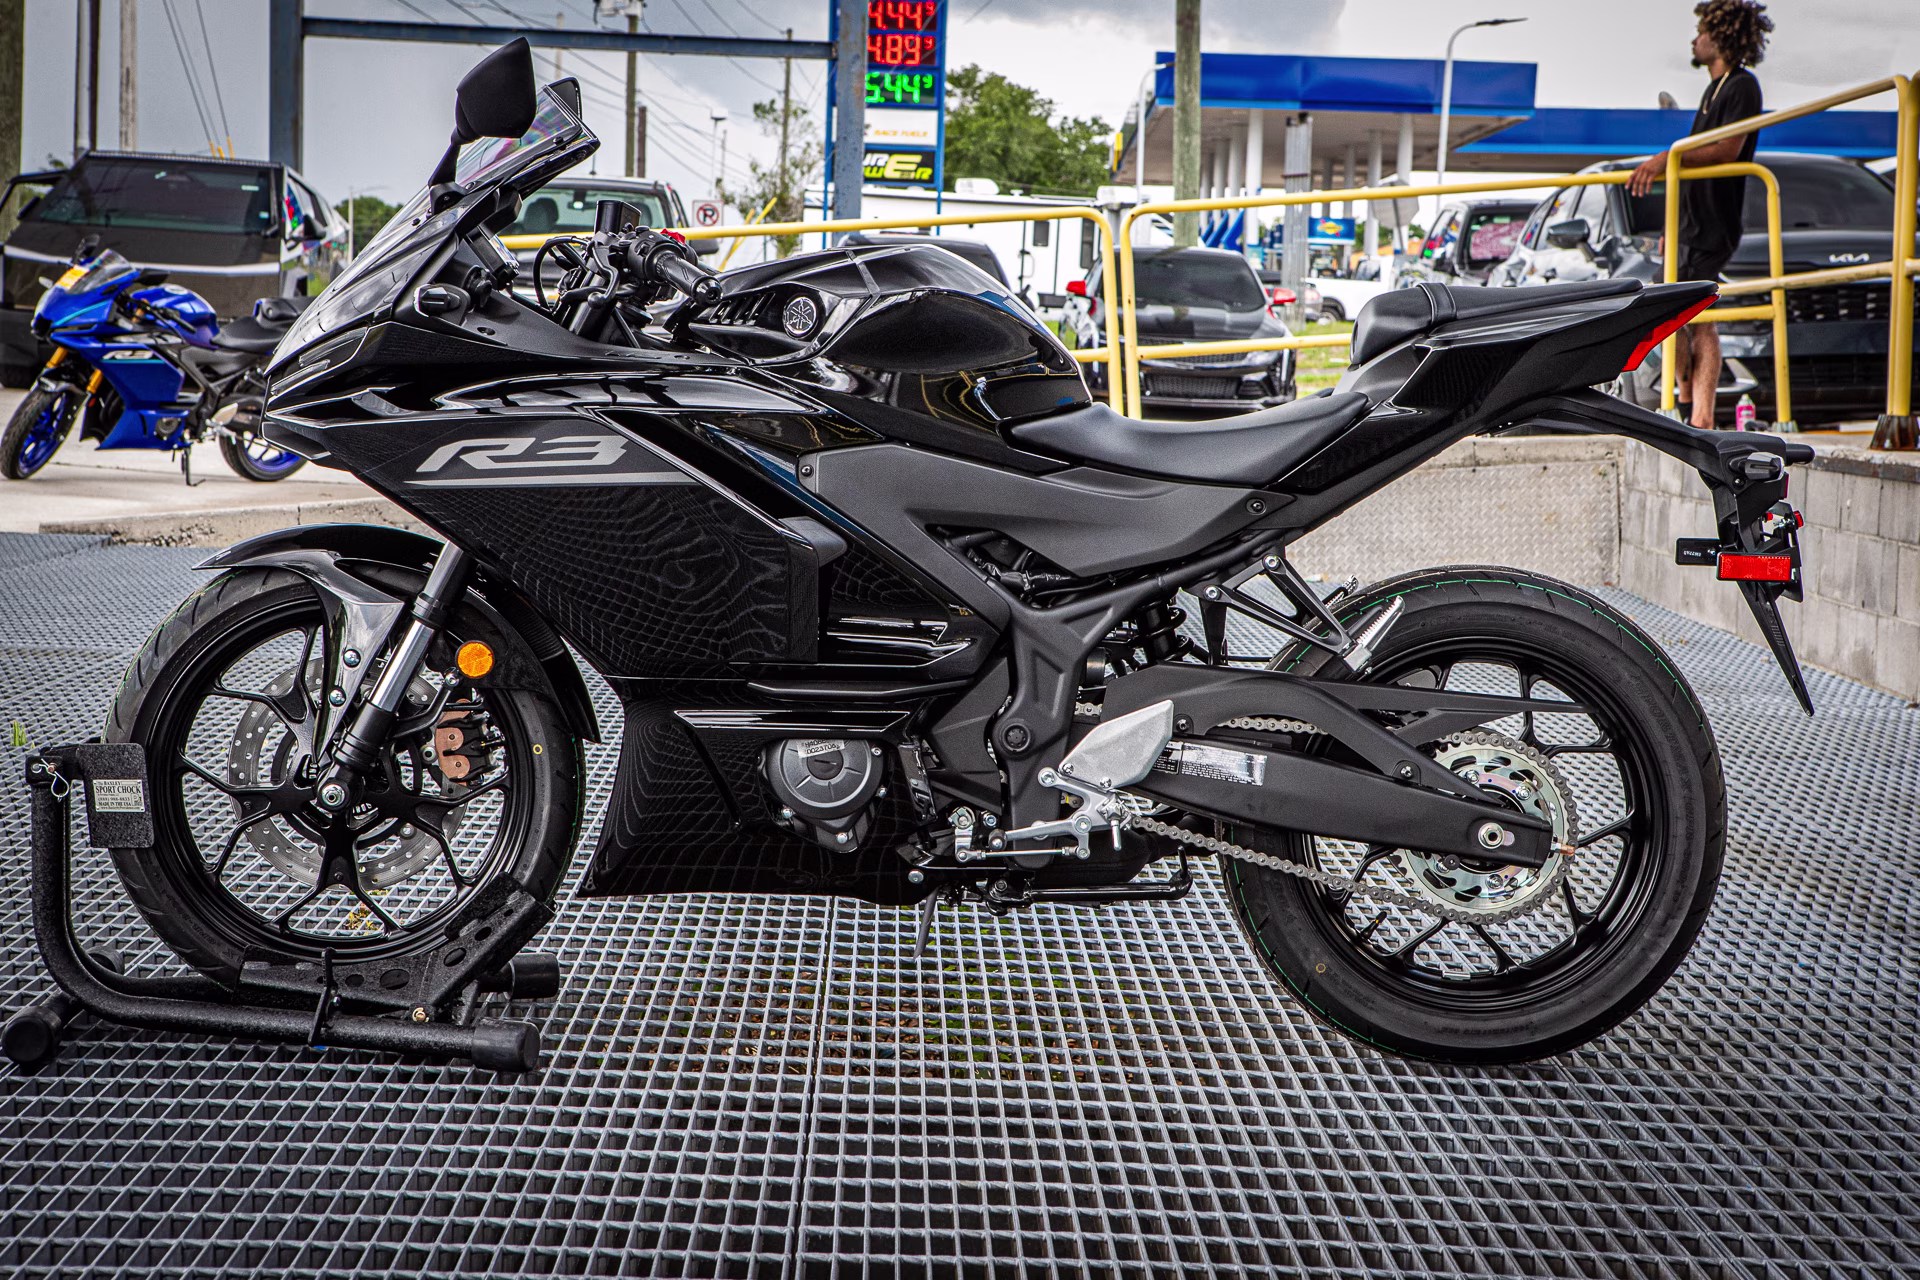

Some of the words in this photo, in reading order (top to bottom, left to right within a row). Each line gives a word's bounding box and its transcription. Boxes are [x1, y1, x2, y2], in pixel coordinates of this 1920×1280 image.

[703, 208, 715, 222] P
[103, 350, 154, 360] R3
[415, 435, 629, 473] R3
